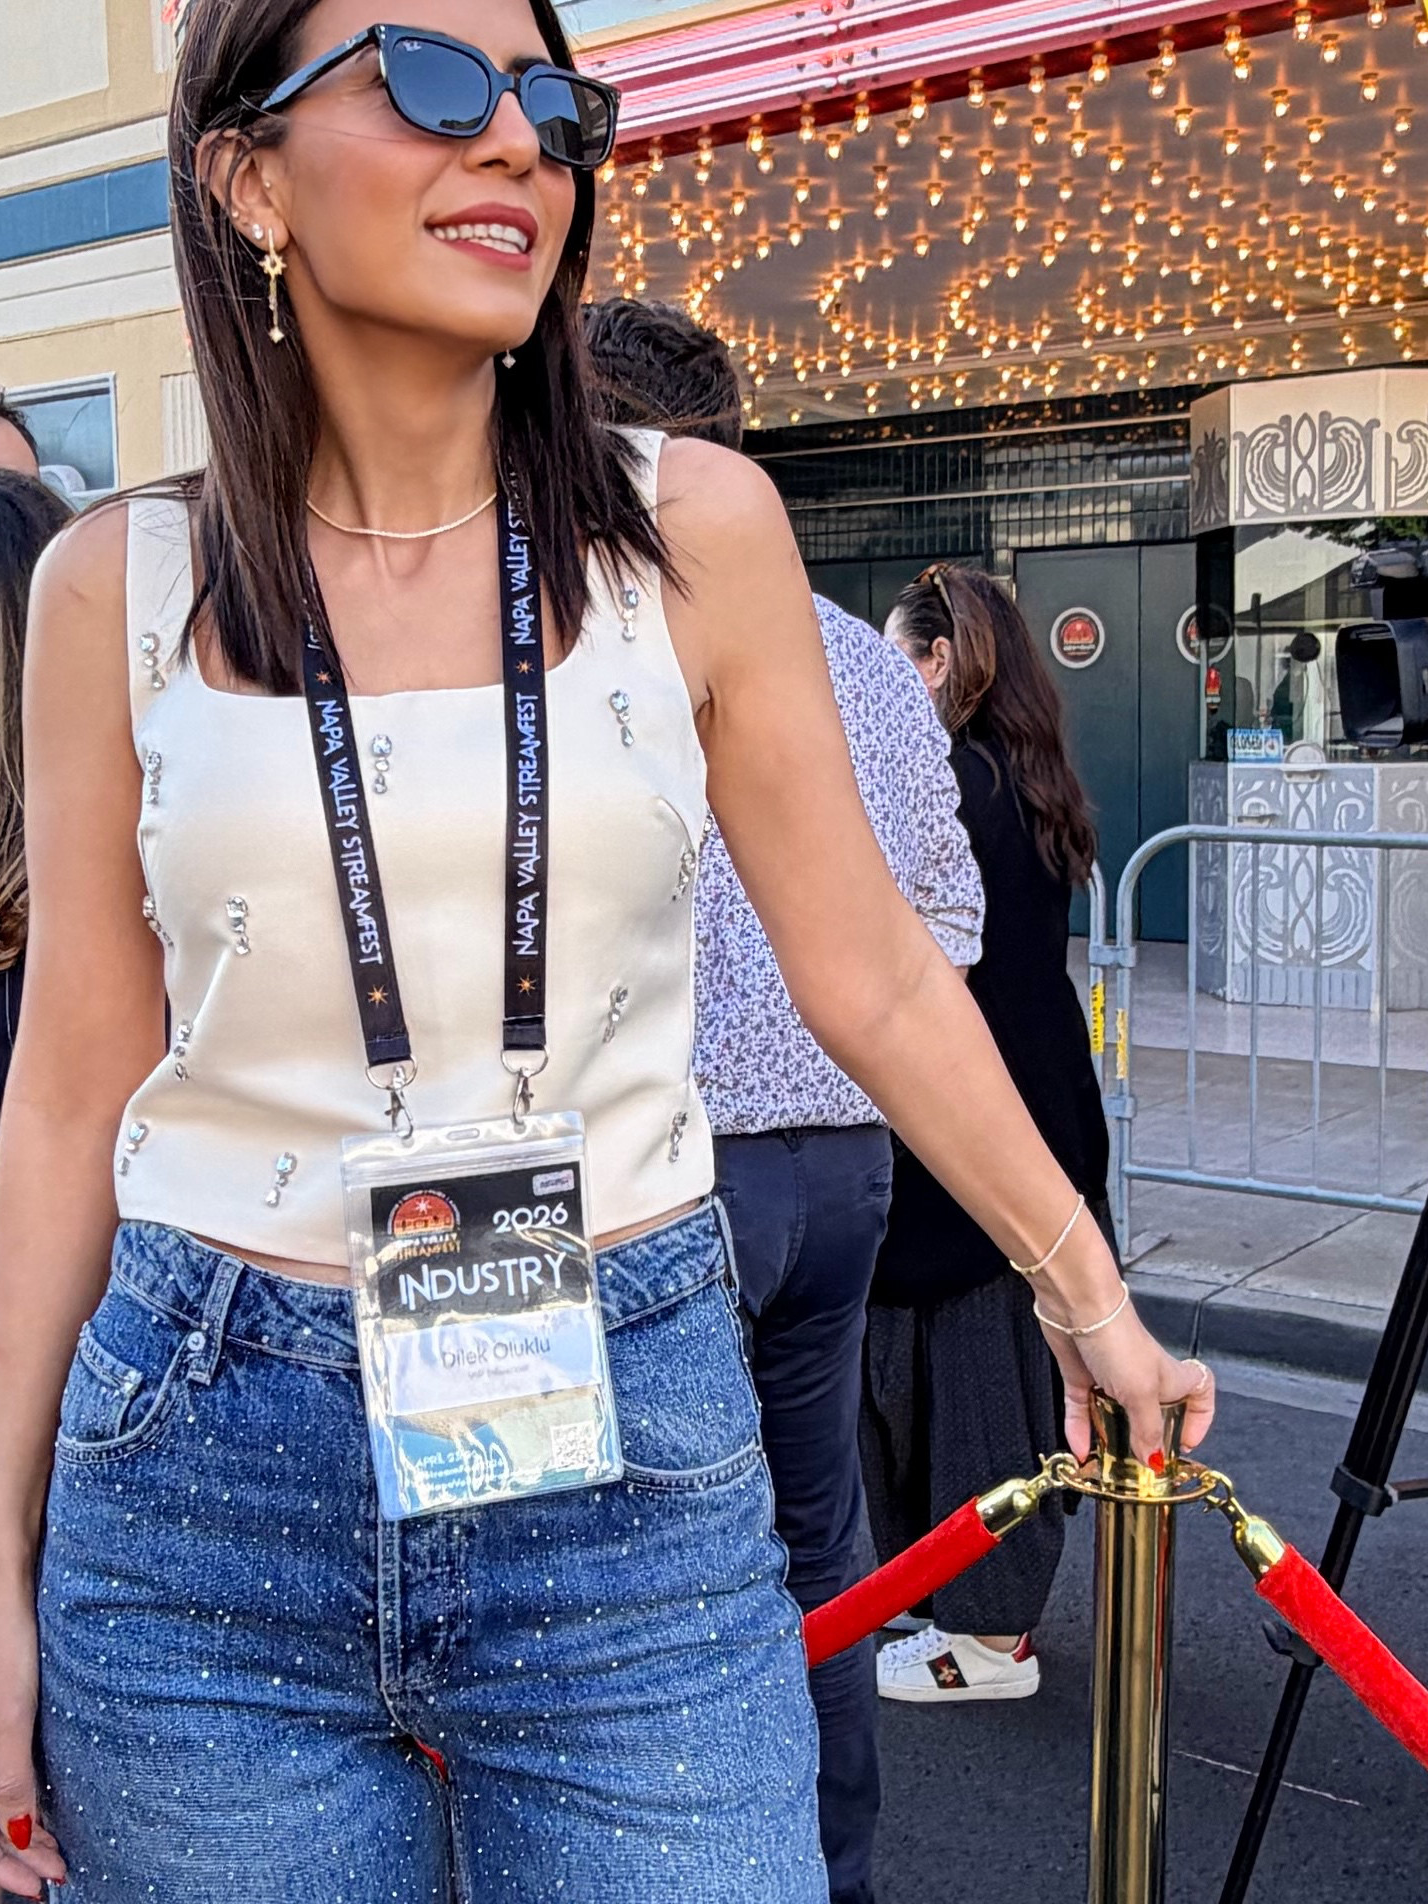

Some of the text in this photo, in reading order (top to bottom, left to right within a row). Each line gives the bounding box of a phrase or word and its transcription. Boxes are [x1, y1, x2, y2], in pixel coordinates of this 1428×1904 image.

[506, 533, 533, 592] VALLEY
[508, 594, 537, 645] NAPA
[315, 700, 383, 966] NAPA VALLEY STREAMFEST
[511, 692, 542, 957] NAPA VALLEY STREAMFEST
[492, 1202, 569, 1234] 2026
[399, 1252, 569, 1311] INDUSTRY
[492, 1336, 552, 1360] Oluklu
